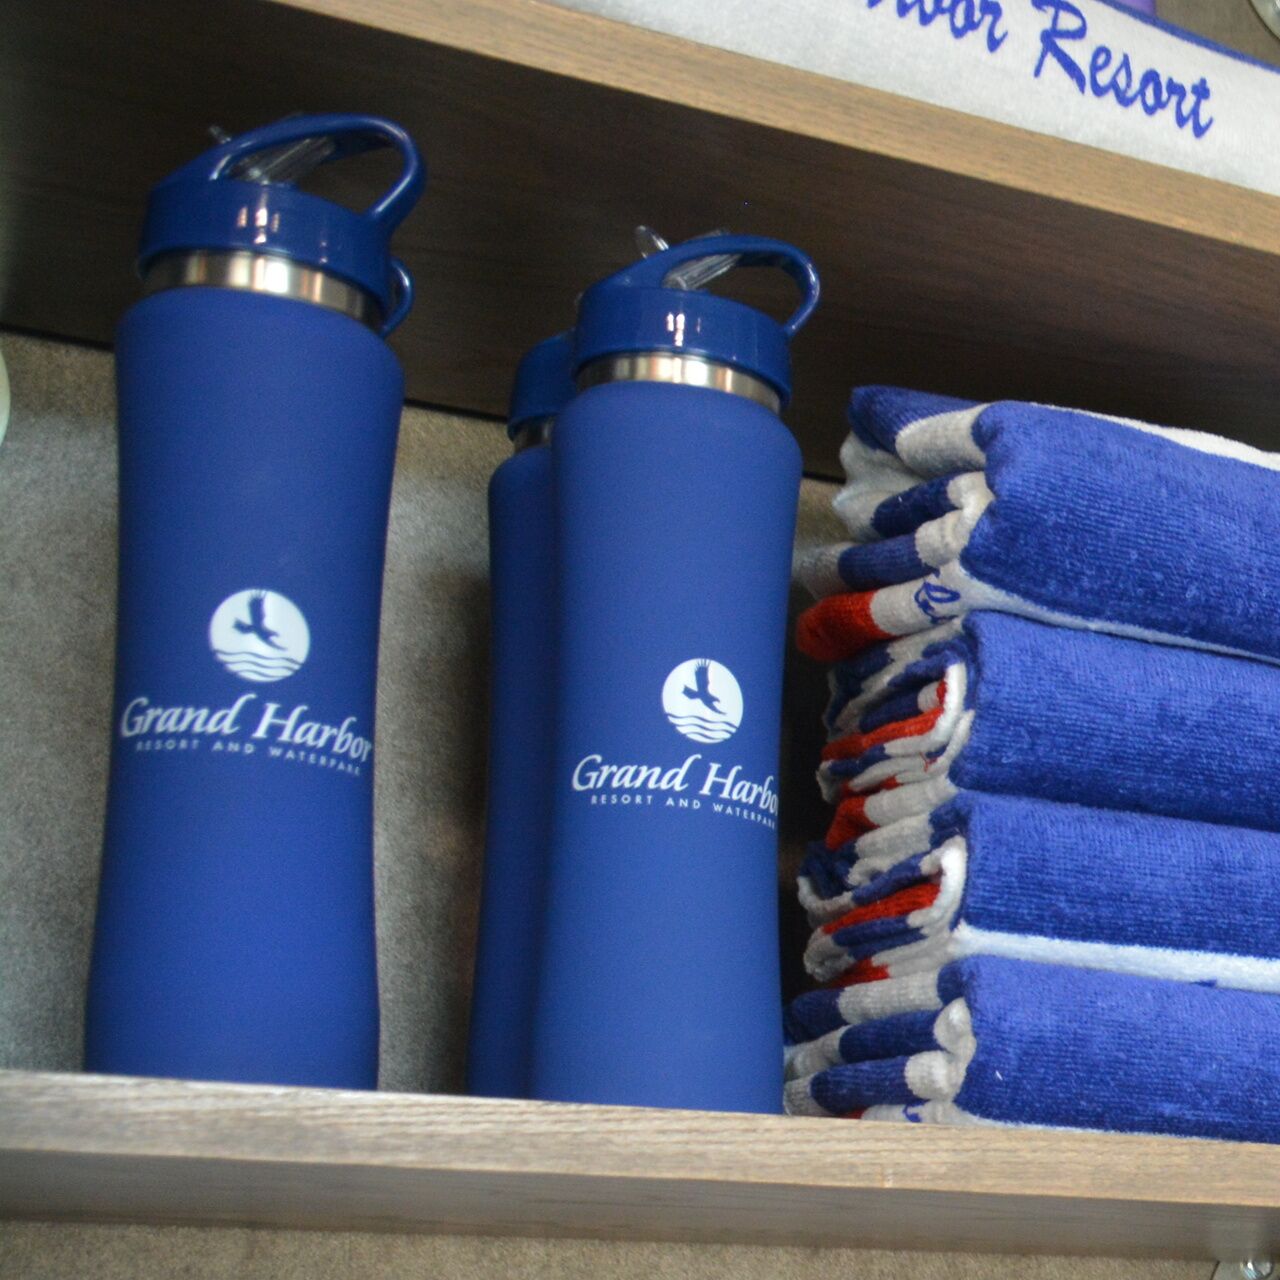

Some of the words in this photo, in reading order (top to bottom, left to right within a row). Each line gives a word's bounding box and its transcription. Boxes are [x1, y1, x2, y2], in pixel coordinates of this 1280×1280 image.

[1030, 0, 1213, 138] Resort
[120, 692, 257, 738] Grand
[252, 702, 373, 762] Harbor
[212, 740, 256, 755] AND
[572, 753, 702, 791] Grand
[699, 761, 779, 817] Harbo
[591, 794, 654, 805] RESORT
[666, 797, 701, 810] AND
